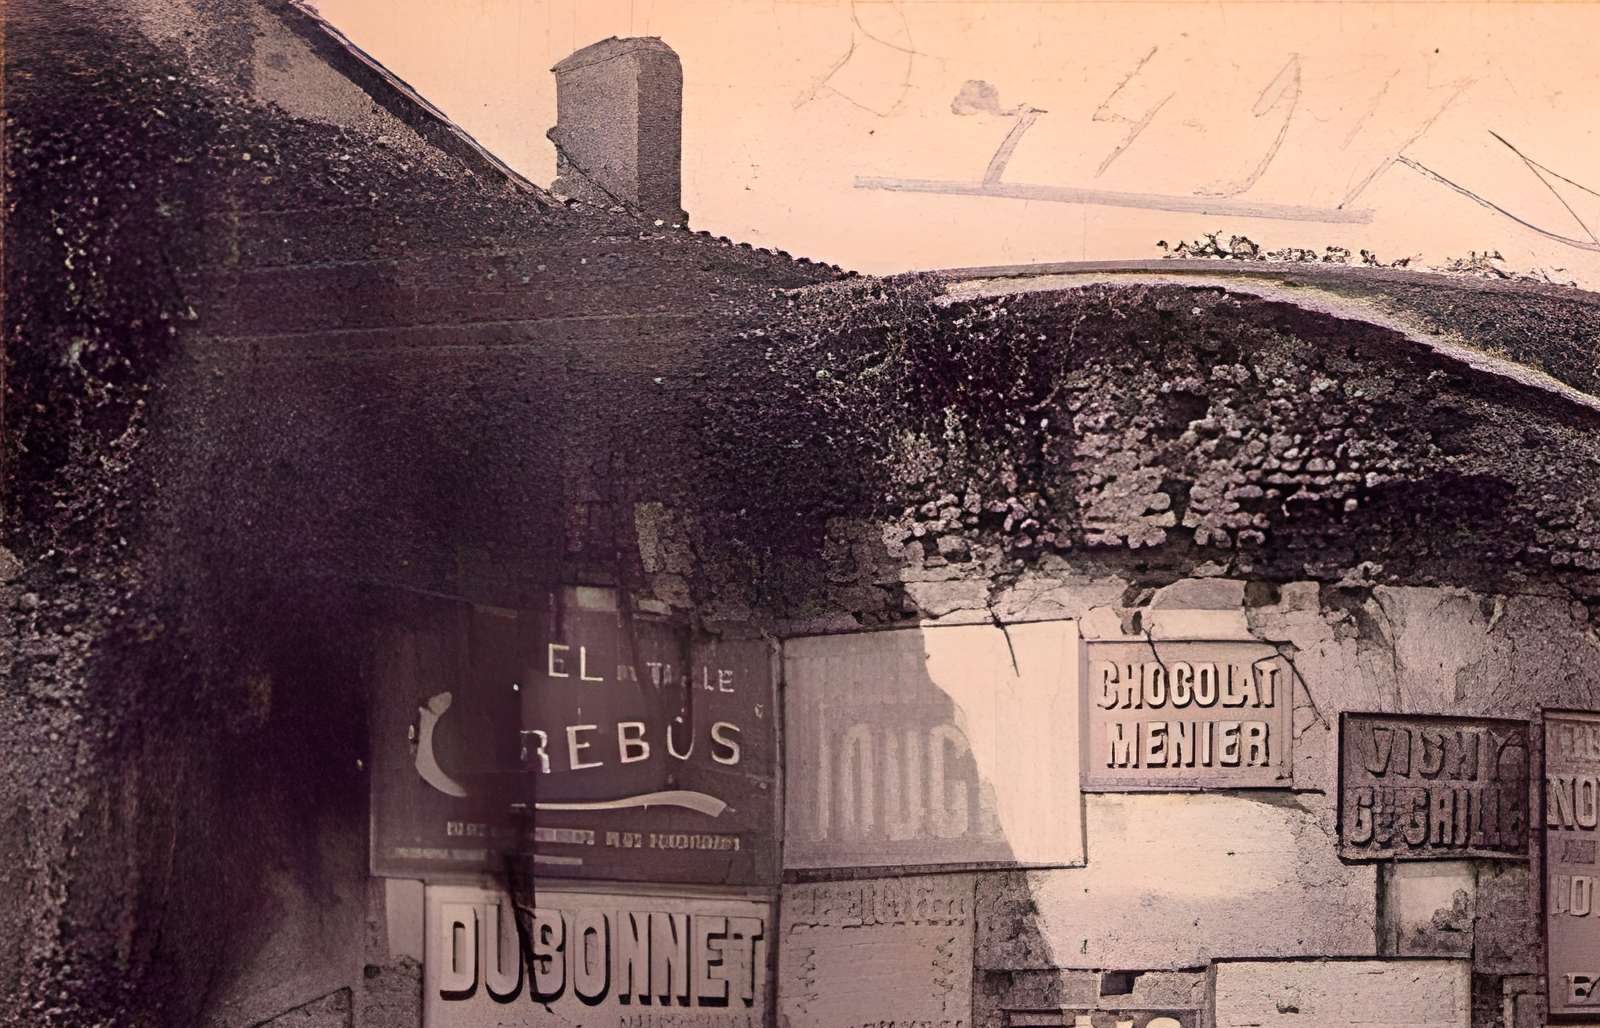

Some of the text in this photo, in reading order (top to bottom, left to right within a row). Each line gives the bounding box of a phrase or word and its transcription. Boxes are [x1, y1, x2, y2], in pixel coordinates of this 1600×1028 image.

[1098, 658, 1282, 710] CHOCOLAT
[1105, 719, 1272, 770] MENIER
[438, 900, 766, 1008] DUBONNET
